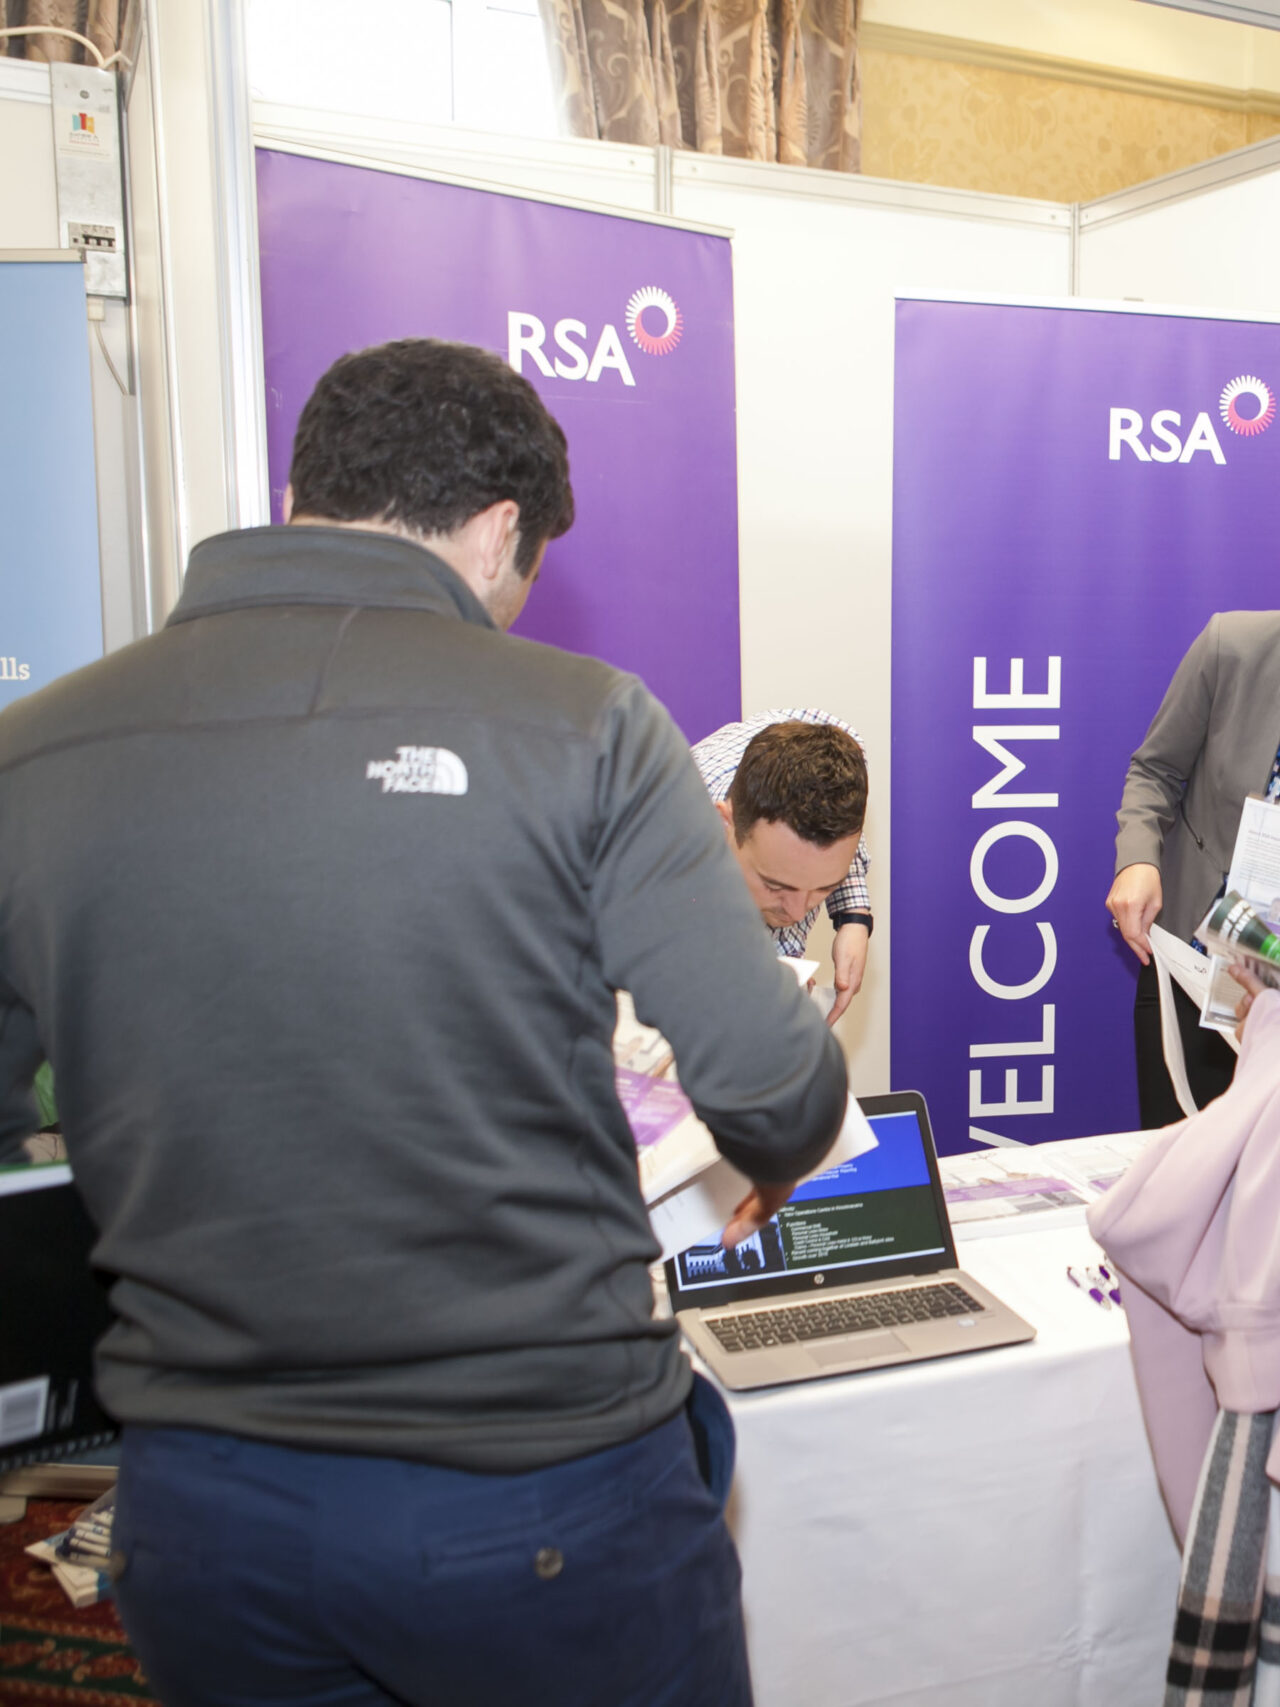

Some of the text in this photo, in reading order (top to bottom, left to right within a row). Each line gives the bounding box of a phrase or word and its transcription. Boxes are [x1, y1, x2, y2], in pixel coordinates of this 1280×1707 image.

[507, 310, 636, 387] RSA
[1108, 407, 1227, 466] RSA
[366, 759, 435, 779] NORTH
[395, 745, 436, 763] THE
[382, 776, 434, 793] FACE
[969, 655, 1062, 1146] ELCOME
